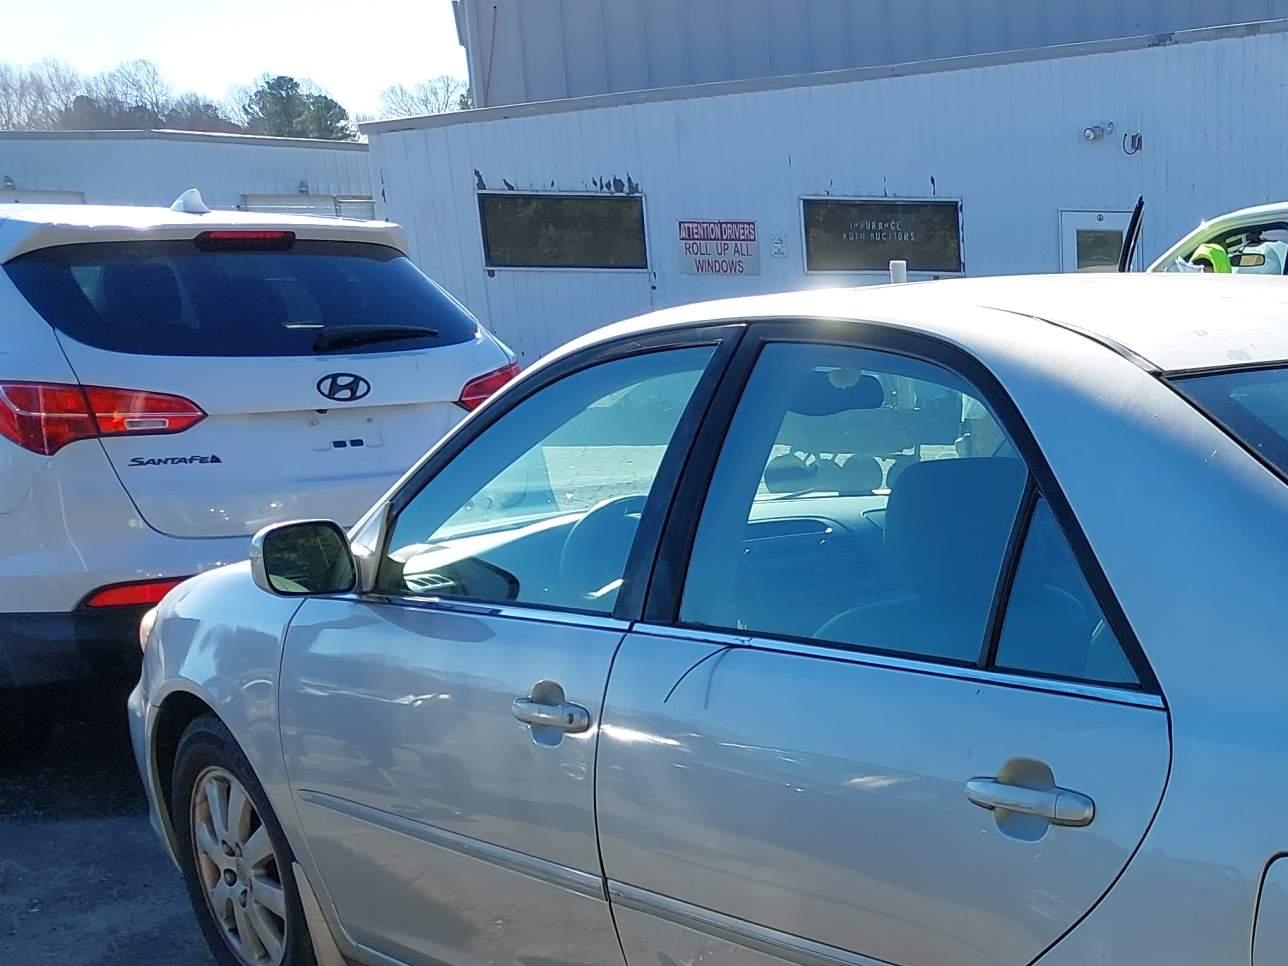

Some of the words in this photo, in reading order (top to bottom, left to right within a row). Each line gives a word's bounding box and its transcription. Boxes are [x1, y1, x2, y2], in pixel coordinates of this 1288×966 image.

[680, 223, 720, 239] ATTENTION
[722, 223, 755, 239] DRIVERS
[684, 242, 711, 256] ROLL
[716, 242, 729, 256] UP
[733, 242, 752, 256] ALL
[695, 259, 744, 274] WINDOWS
